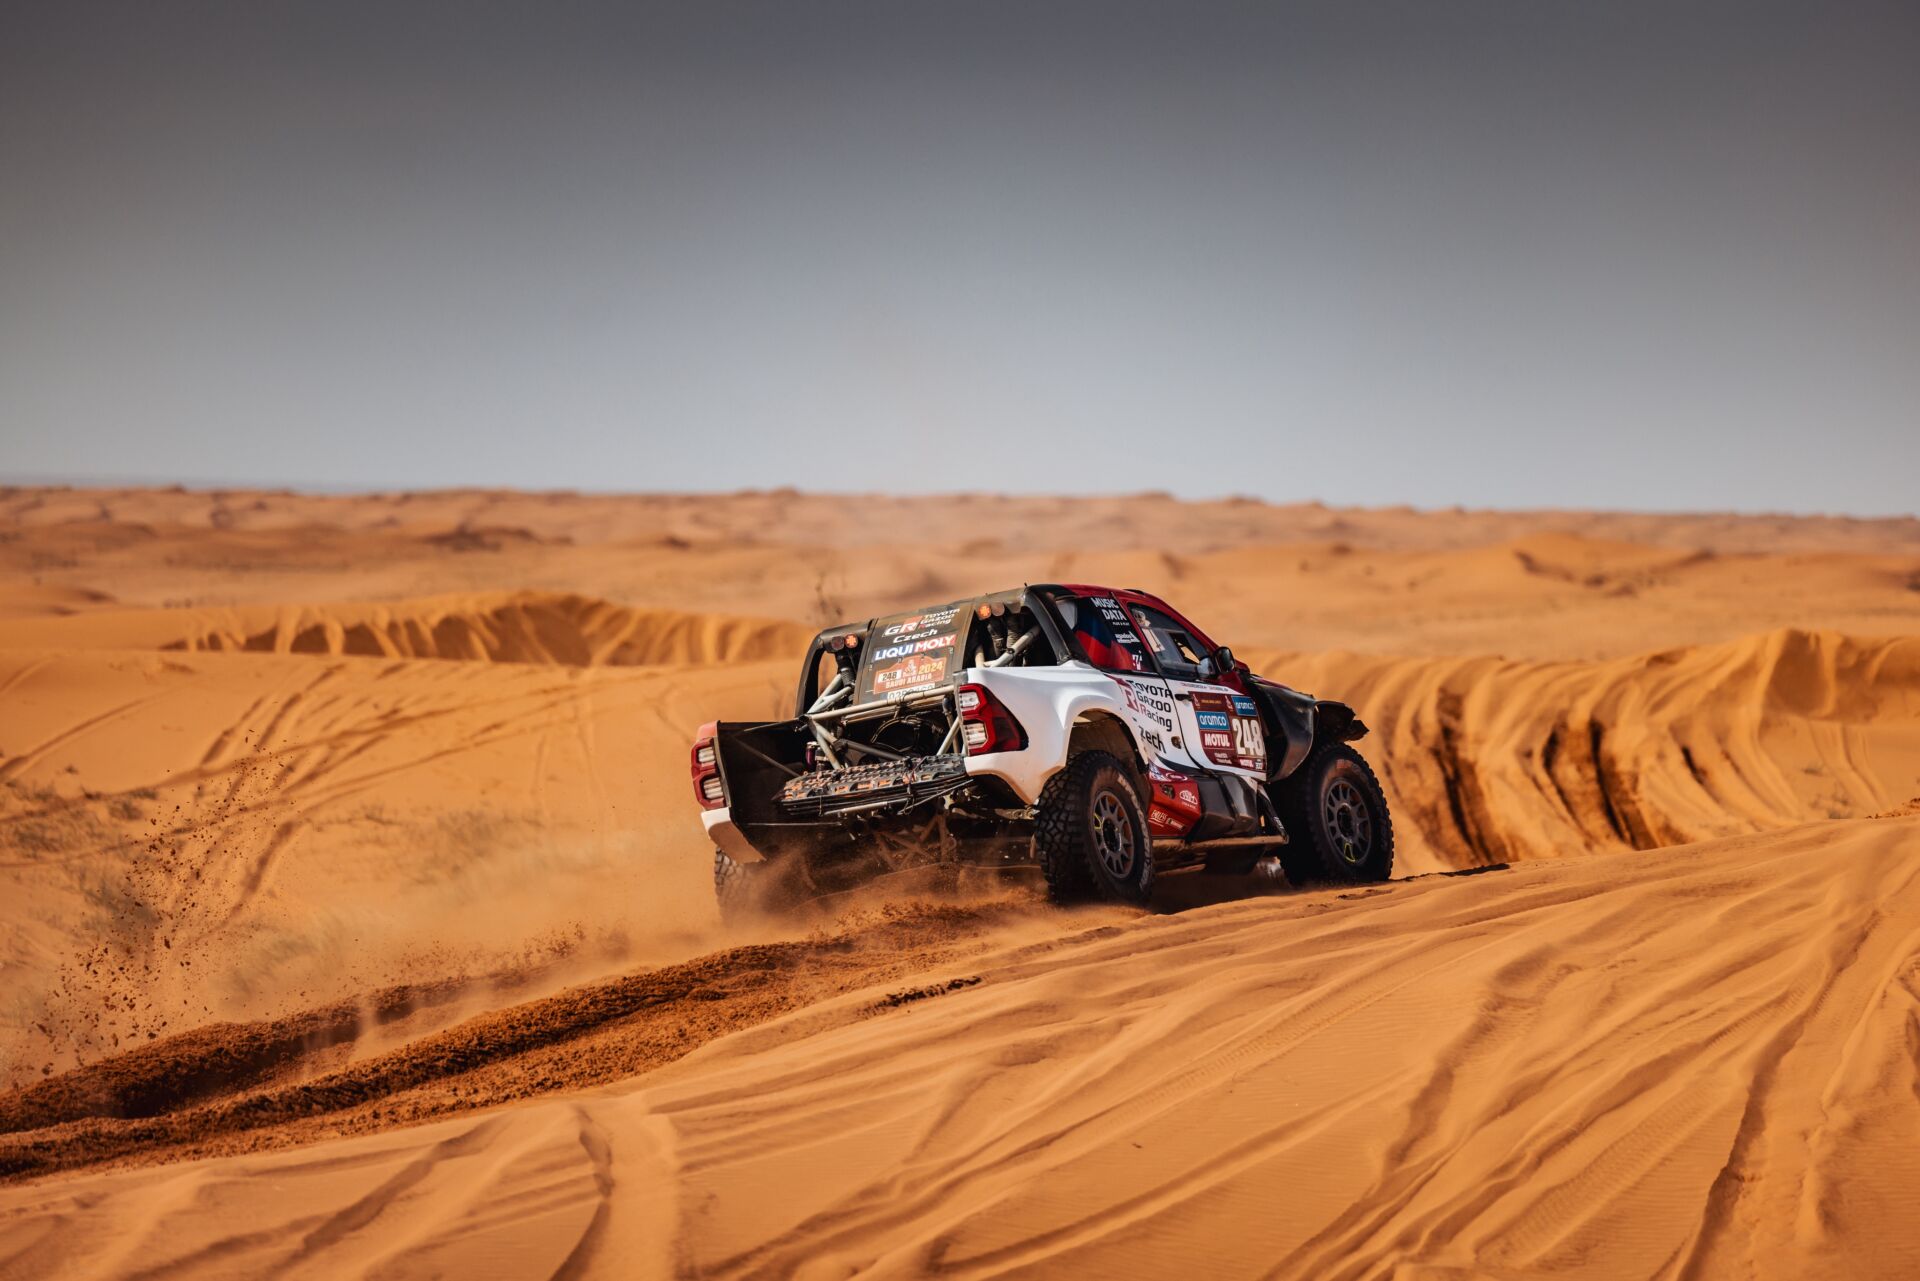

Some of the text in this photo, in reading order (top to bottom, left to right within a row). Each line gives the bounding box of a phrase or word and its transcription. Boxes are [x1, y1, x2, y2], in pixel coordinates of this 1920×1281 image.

[1091, 597, 1119, 608] MUSIC
[1101, 609, 1127, 620] DATA
[884, 621, 918, 636] GR
[875, 634, 955, 661] LIQUI MOLY
[882, 671, 897, 680] 248
[918, 661, 944, 675] 2024
[885, 680, 906, 688] SAUDI
[906, 673, 932, 684] ARABIA
[1126, 680, 1173, 700] TOYOTA
[1136, 691, 1171, 713] GAZOO
[1235, 701, 1254, 710] aramco
[1140, 704, 1172, 732] Racing
[1199, 714, 1227, 726] aramco
[1132, 717, 1166, 754] zech
[1204, 733, 1230, 747] MOTUL
[1232, 718, 1264, 756] 248
